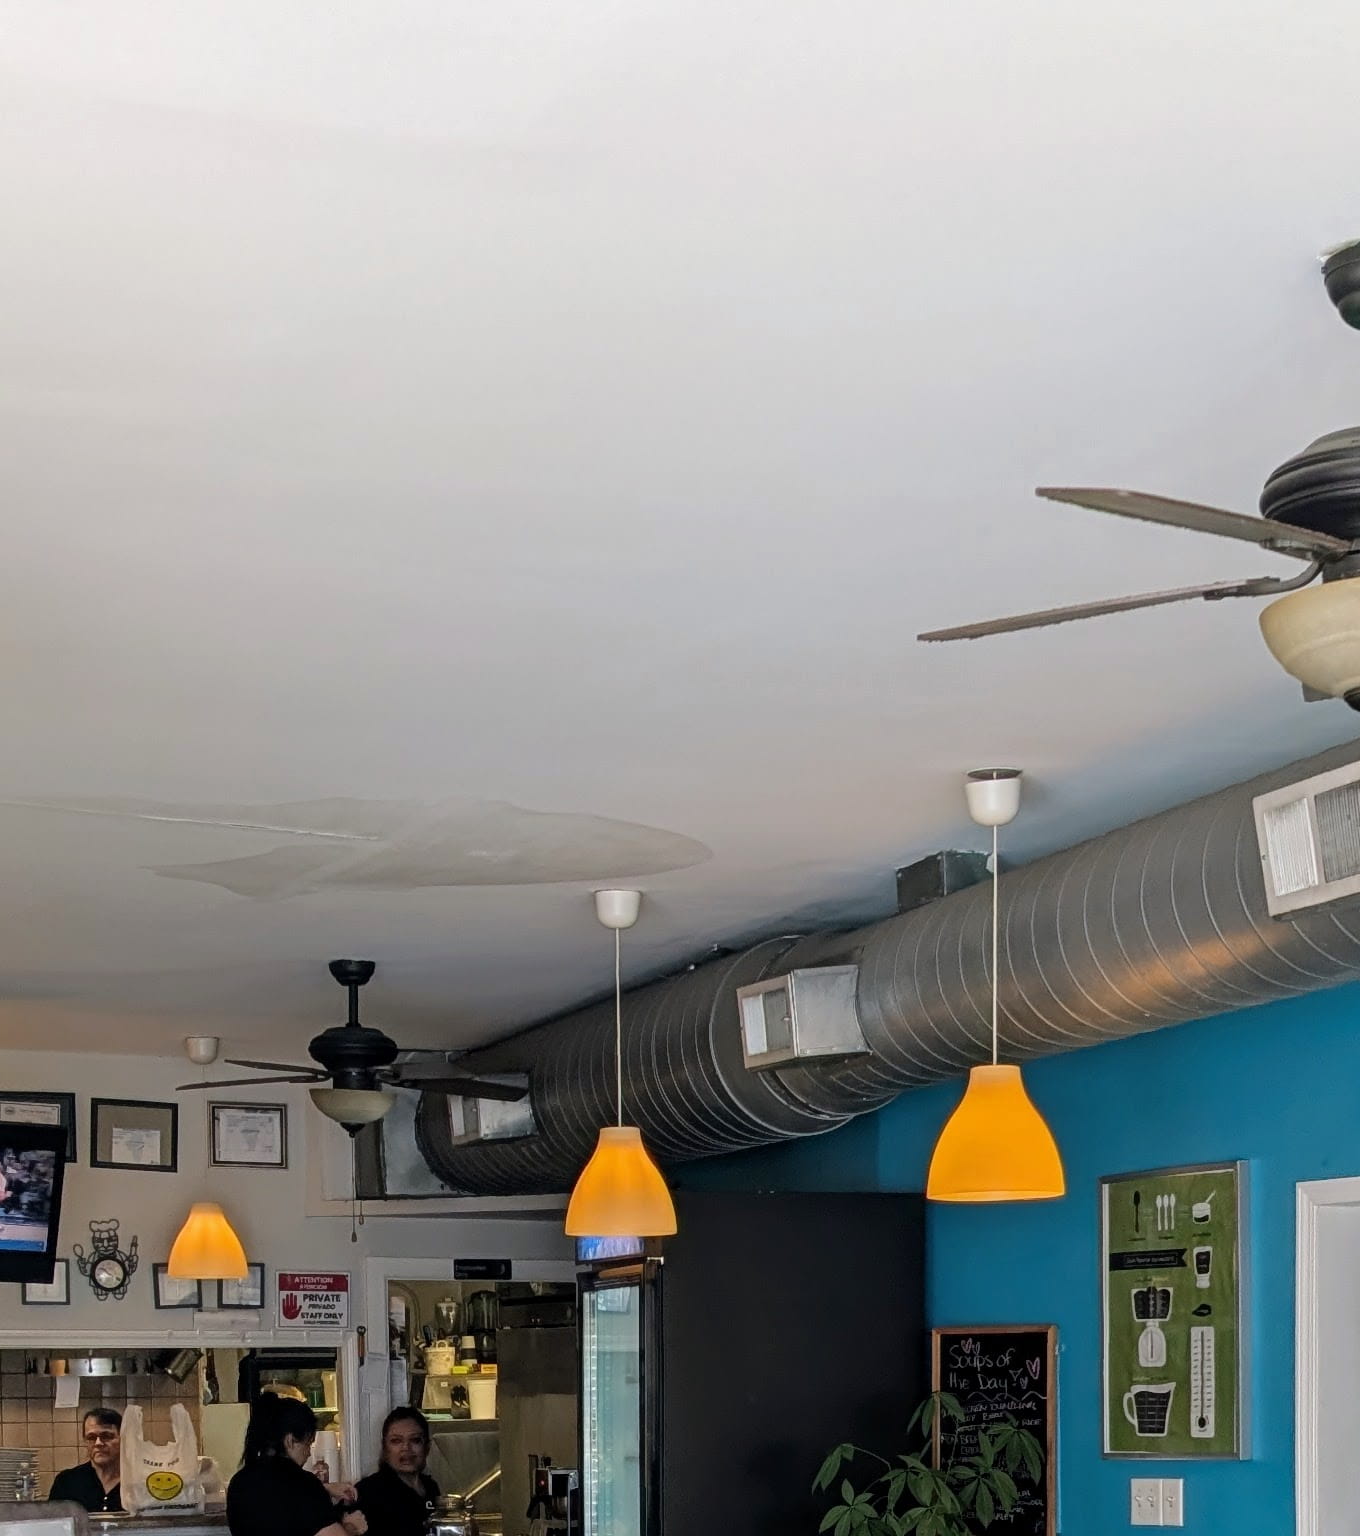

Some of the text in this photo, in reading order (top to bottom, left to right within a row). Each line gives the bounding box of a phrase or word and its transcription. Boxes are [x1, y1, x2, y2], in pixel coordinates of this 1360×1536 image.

[294, 1276, 334, 1284] ATTENTION
[302, 1293, 341, 1303] PRIVATE
[323, 1312, 344, 1320] ONLY
[949, 1344, 1016, 1371] Soups of
